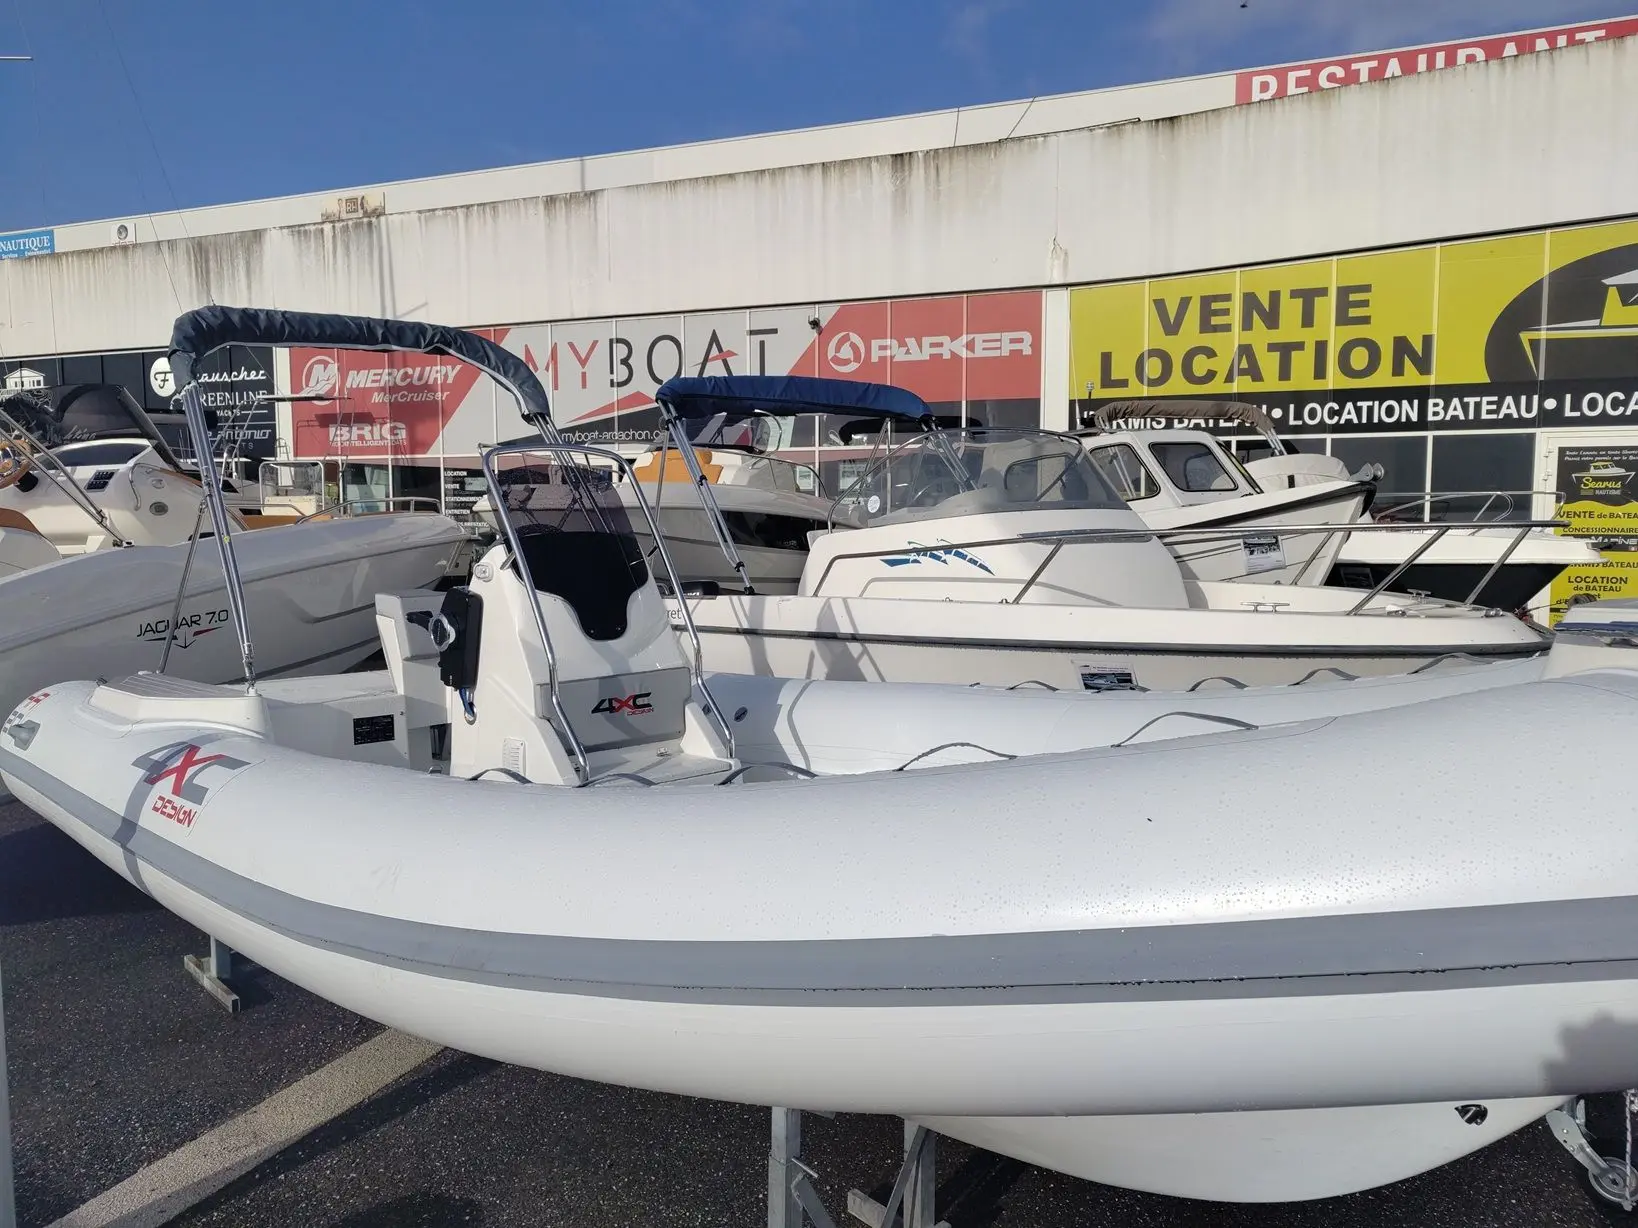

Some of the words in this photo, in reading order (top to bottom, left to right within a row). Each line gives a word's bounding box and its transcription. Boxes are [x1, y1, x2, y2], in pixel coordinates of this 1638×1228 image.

[1152, 284, 1372, 336] VENTE
[871, 331, 1033, 363] PARKER
[1100, 334, 1435, 389] LOCATION
[346, 365, 463, 389] MERCURY
[371, 390, 450, 404] MerCruiser
[1288, 398, 1419, 426] LOCATION
[1427, 394, 1539, 422] BATEAU
[329, 422, 407, 441] BRIG
[1559, 511, 1595, 519] VENTE
[1567, 576, 1628, 585] LOCATION
[137, 614, 202, 637] JAGUAR
[205, 609, 229, 625] 7.0
[151, 795, 197, 828] DESIGN
